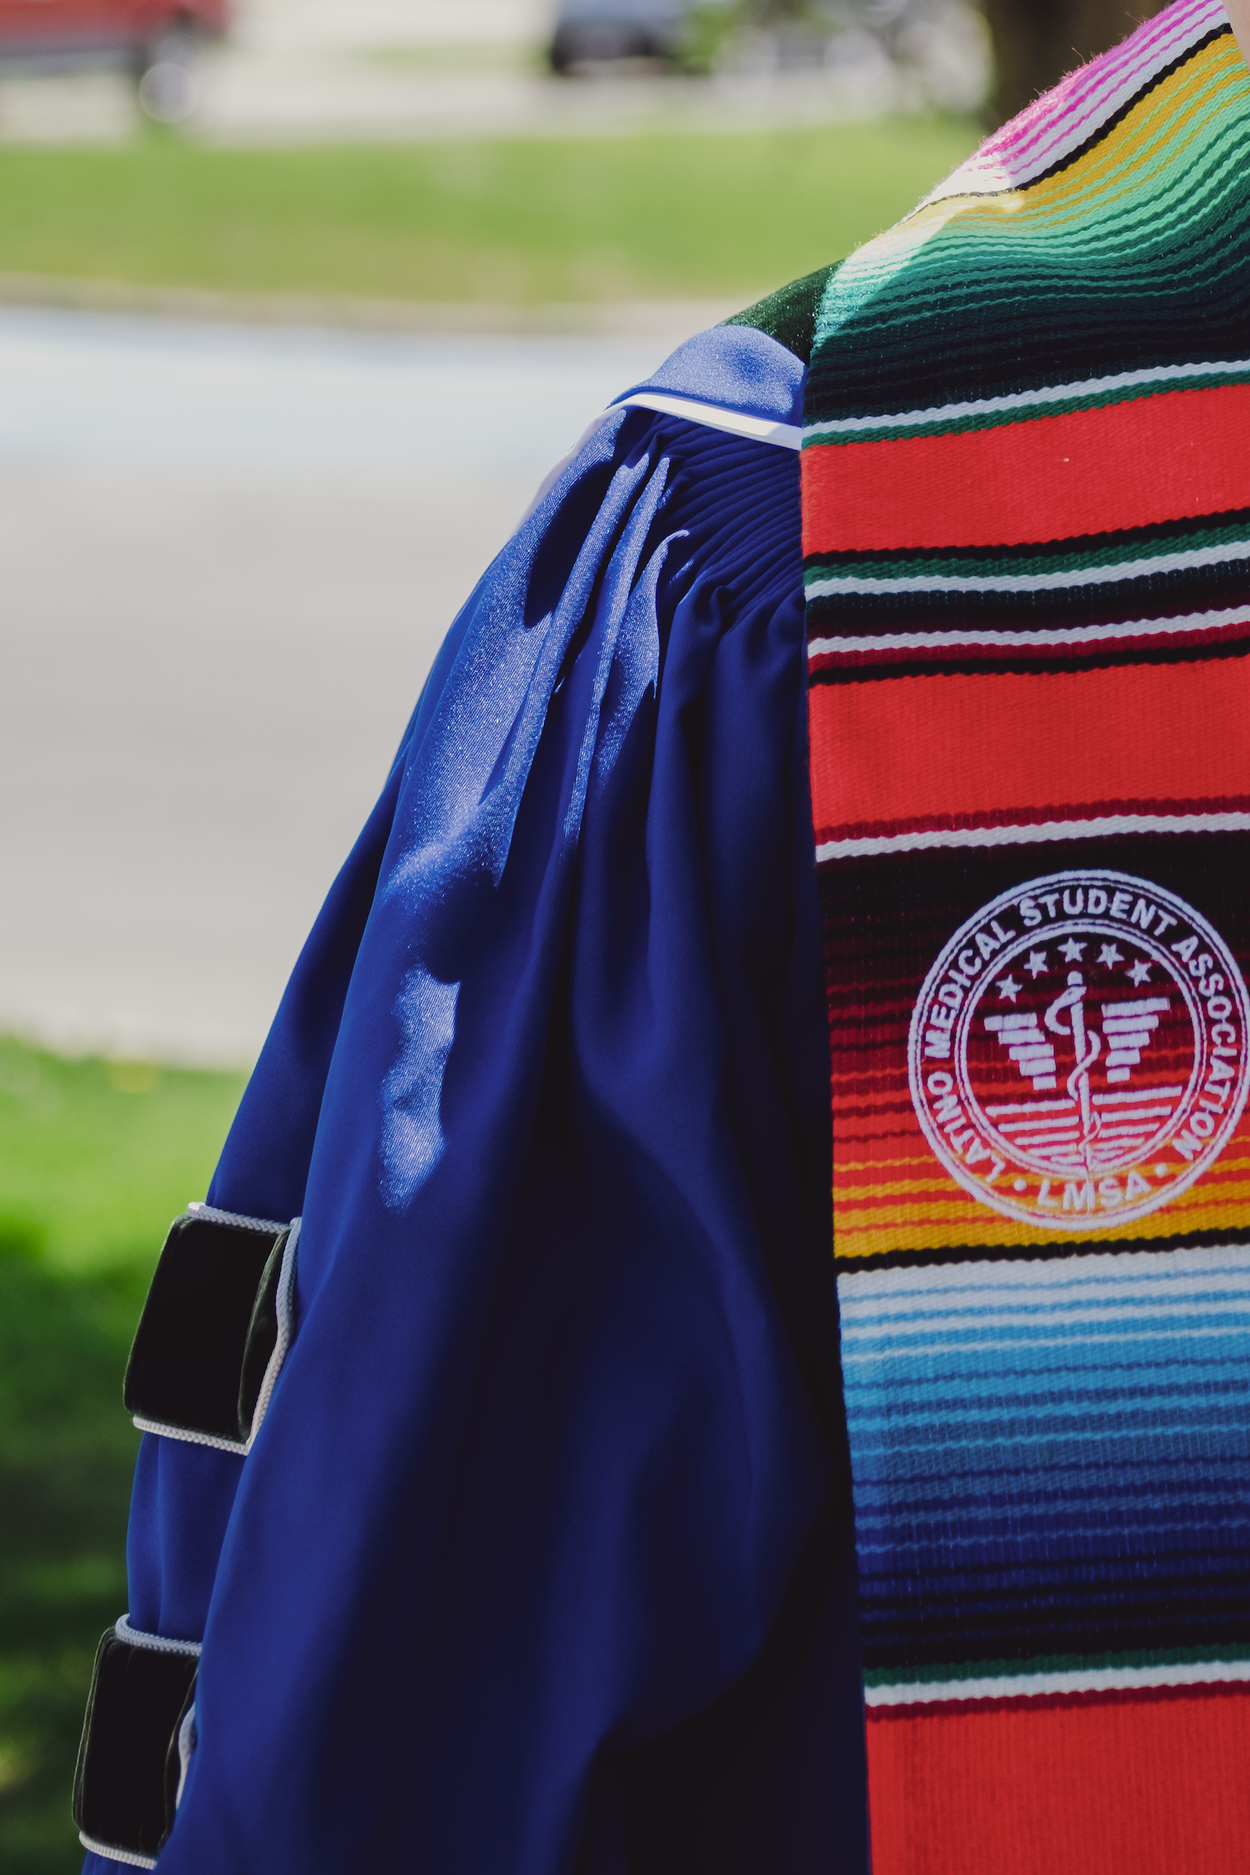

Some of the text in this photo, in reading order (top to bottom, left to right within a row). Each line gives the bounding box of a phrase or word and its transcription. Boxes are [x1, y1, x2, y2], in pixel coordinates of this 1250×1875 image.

[924, 888, 1238, 1183] LATINO MEDICAL STUDENT ASSOCIATION
[1036, 1174, 1152, 1211] LMSA
